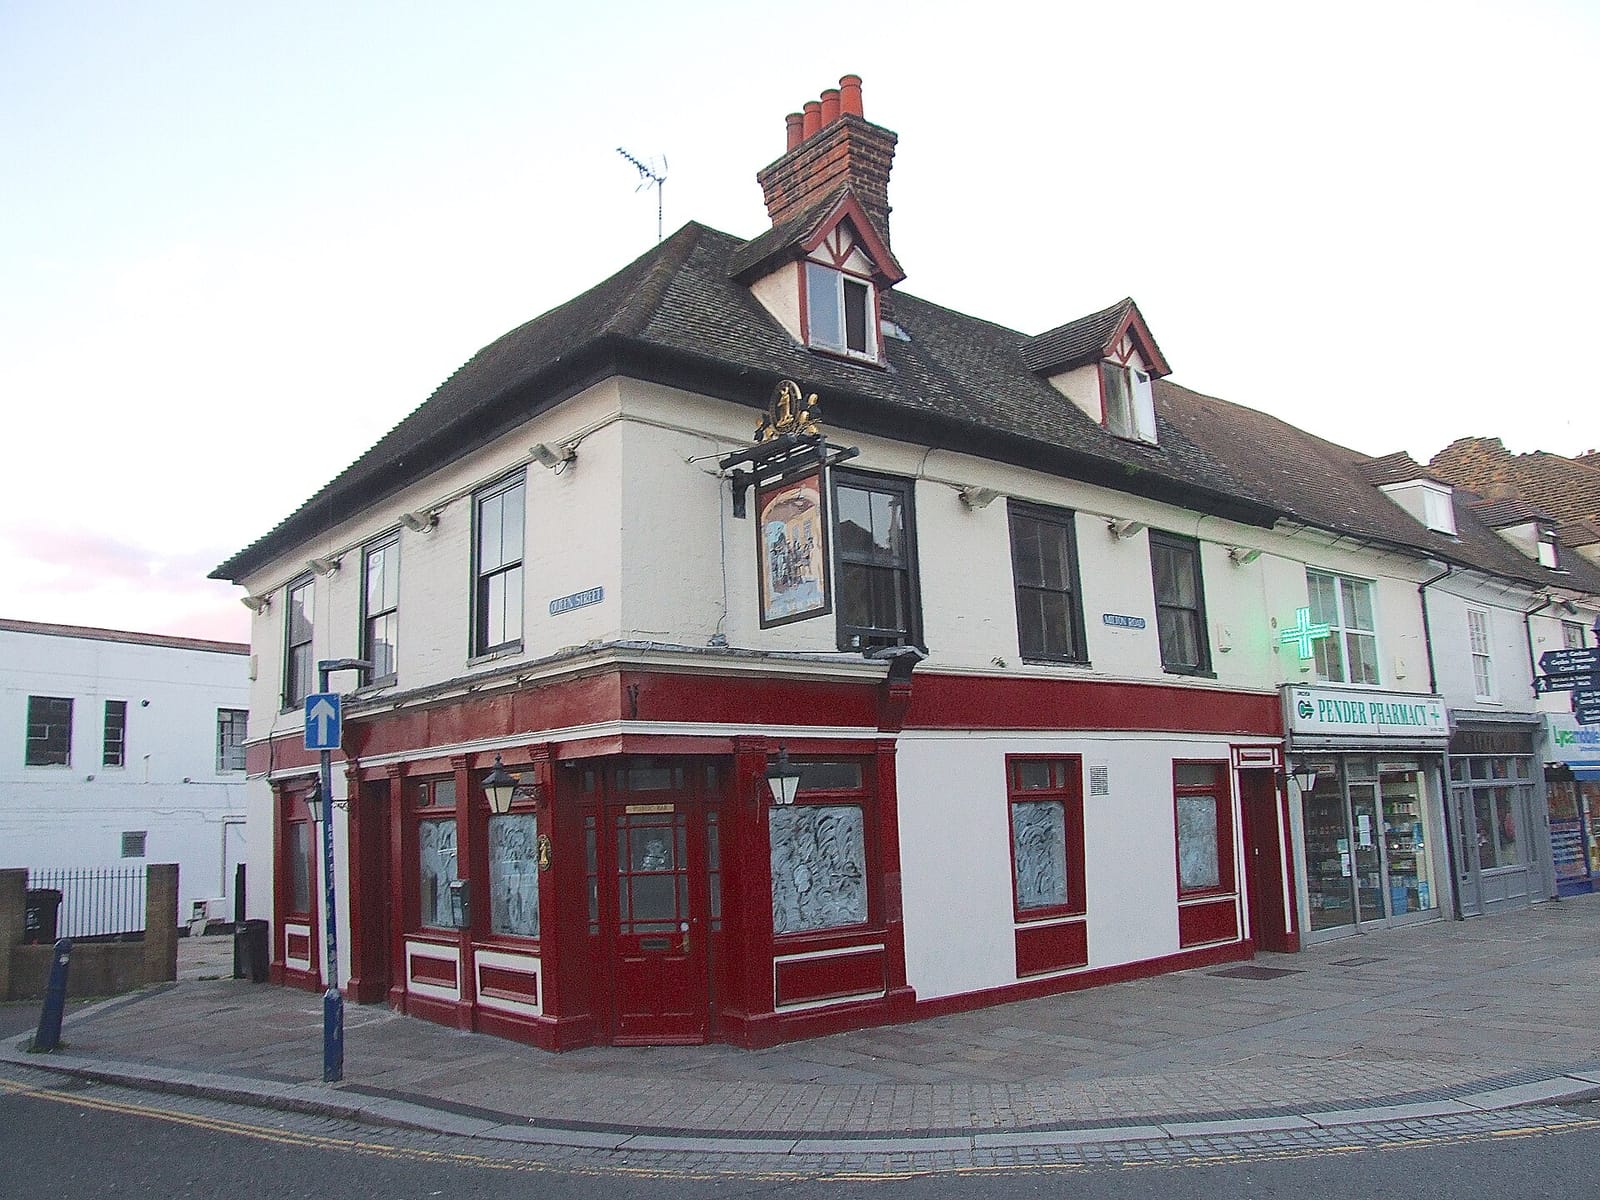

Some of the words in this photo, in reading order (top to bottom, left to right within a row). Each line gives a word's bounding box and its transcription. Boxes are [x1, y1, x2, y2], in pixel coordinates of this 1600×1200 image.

[575, 589, 602, 606] STREET
[1317, 699, 1367, 724] PENDER
[1369, 702, 1428, 726] PHARMACY
